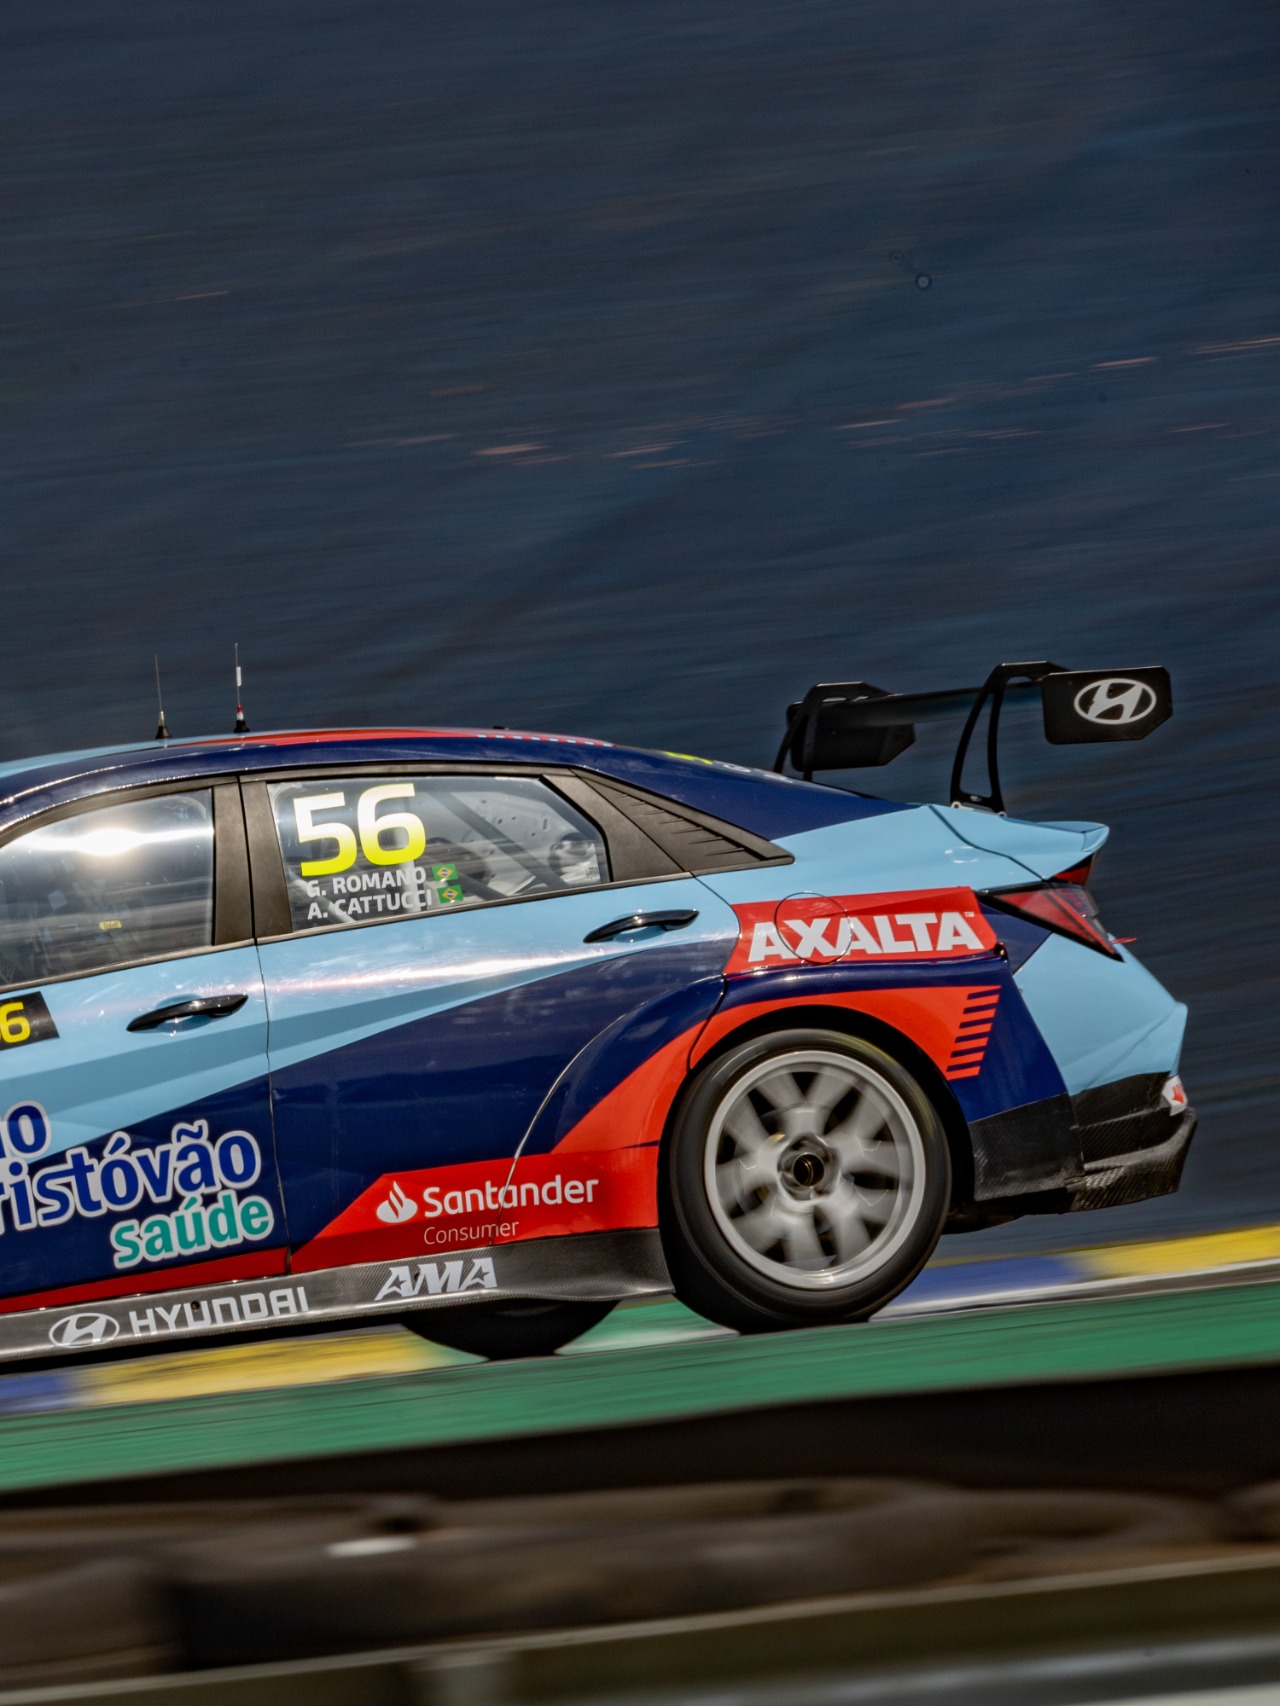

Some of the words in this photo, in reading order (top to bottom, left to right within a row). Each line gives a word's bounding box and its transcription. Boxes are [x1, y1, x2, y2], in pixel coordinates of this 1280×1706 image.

[293, 783, 426, 877] 56
[332, 867, 427, 894] ROMANO
[307, 902, 328, 920] A.
[334, 889, 432, 915] CATTUCCI
[748, 911, 984, 962] AXALTA
[423, 1174, 599, 1218] Santander
[113, 1194, 273, 1267] saúde
[423, 1221, 520, 1245] Consumer
[374, 1257, 499, 1301] AMA
[128, 1286, 310, 1337] HYUNDAI
